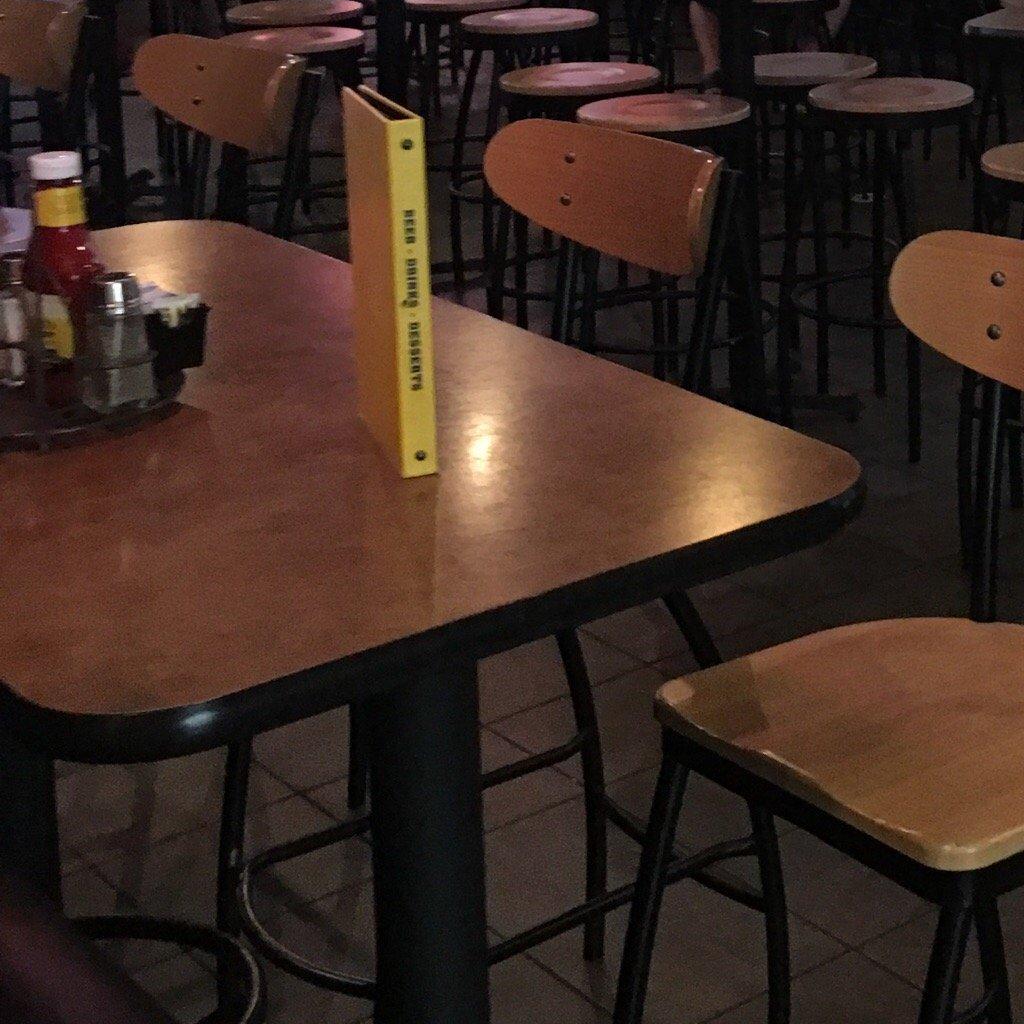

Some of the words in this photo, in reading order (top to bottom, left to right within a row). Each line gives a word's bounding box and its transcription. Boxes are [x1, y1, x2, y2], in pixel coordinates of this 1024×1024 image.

[402, 209, 417, 244] BEER
[405, 258, 420, 308] DRINKS
[408, 322, 424, 391] DESSERTS
